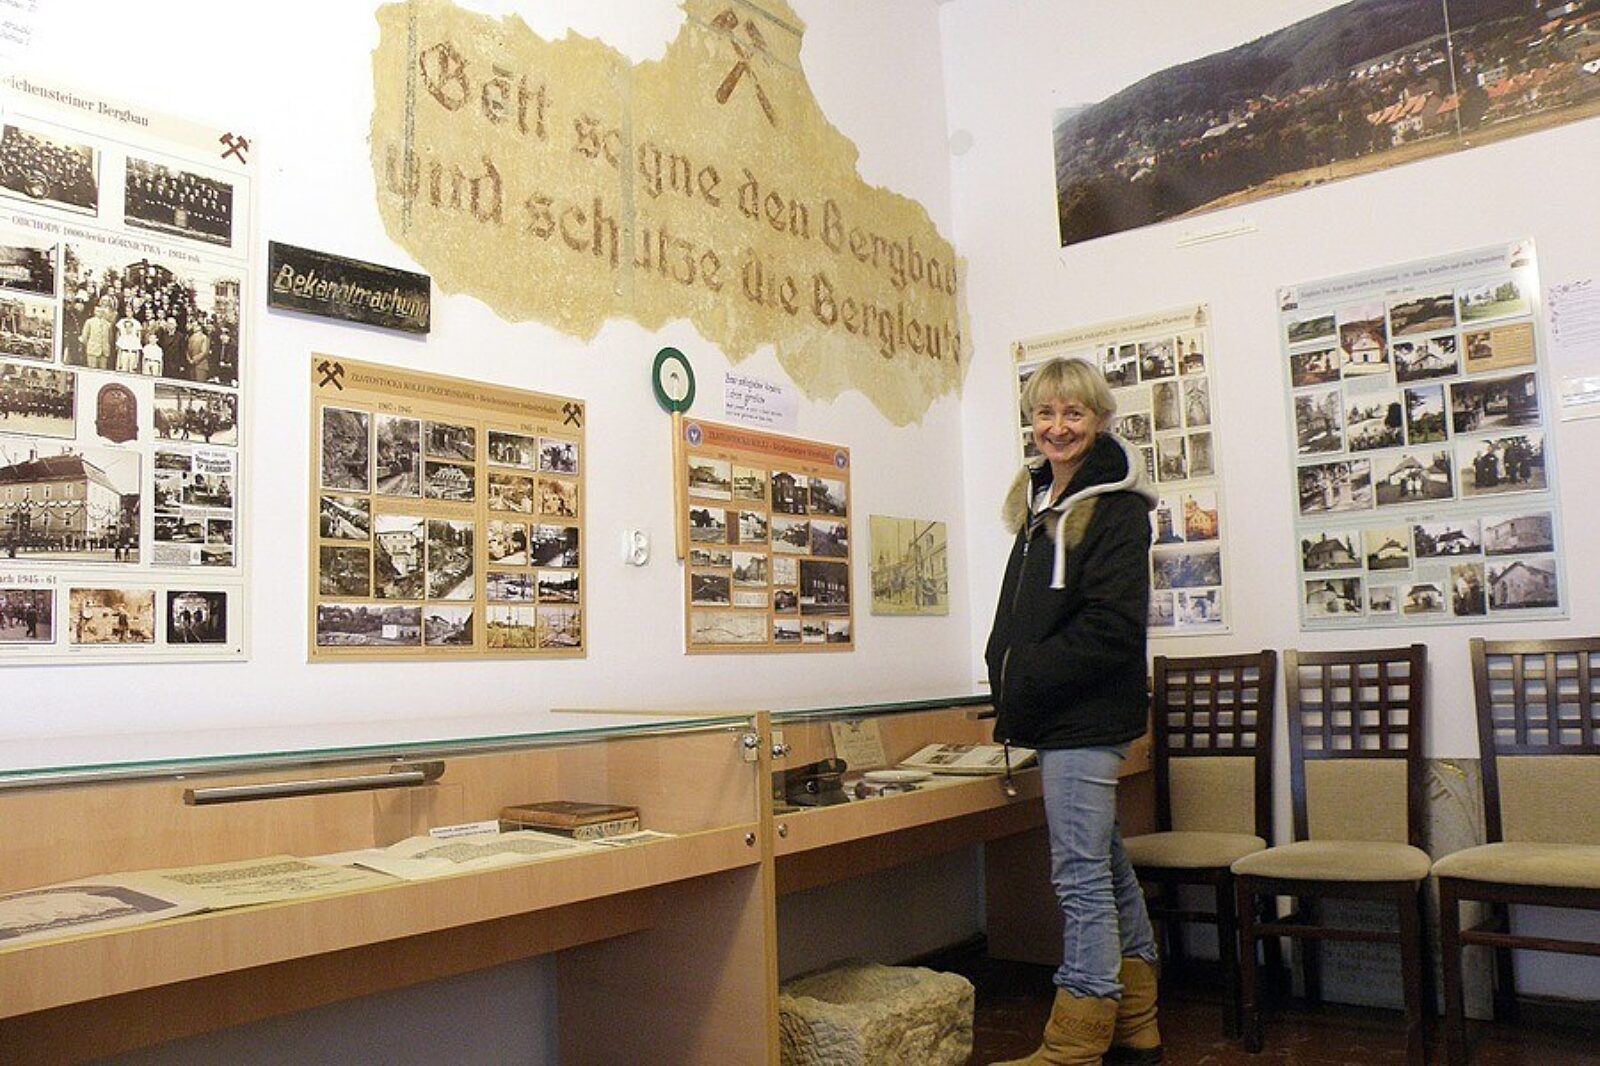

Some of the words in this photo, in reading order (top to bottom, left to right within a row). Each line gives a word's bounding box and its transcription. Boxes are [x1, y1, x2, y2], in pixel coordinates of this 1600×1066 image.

[98, 102, 150, 127] Bergbau
[737, 167, 810, 240] den
[821, 199, 958, 297] Bergbau
